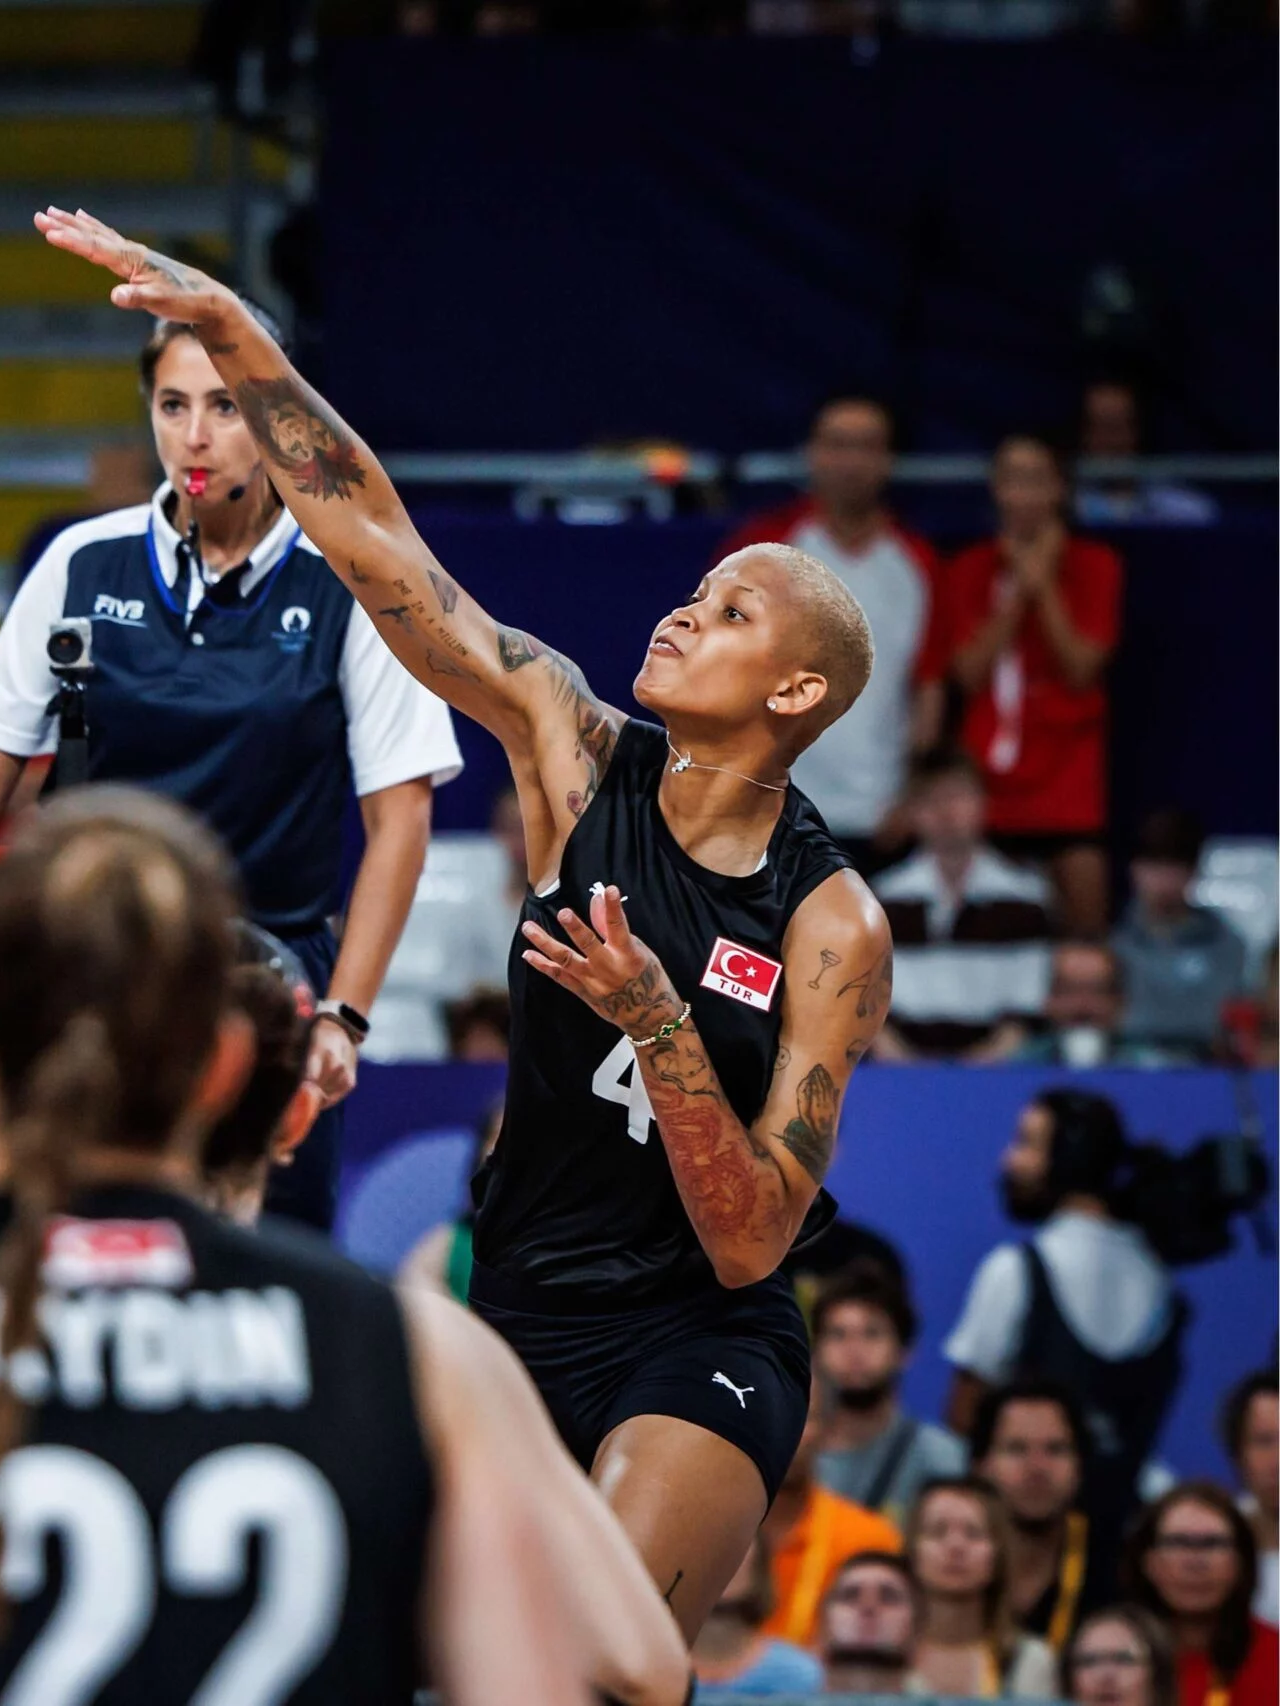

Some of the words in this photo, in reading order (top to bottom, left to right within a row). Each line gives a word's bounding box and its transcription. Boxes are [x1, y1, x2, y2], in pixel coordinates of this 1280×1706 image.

[94, 594, 145, 620] FIVB
[412, 601, 425, 614] IN
[719, 978, 754, 1002] TUR
[591, 1033, 657, 1145] 4
